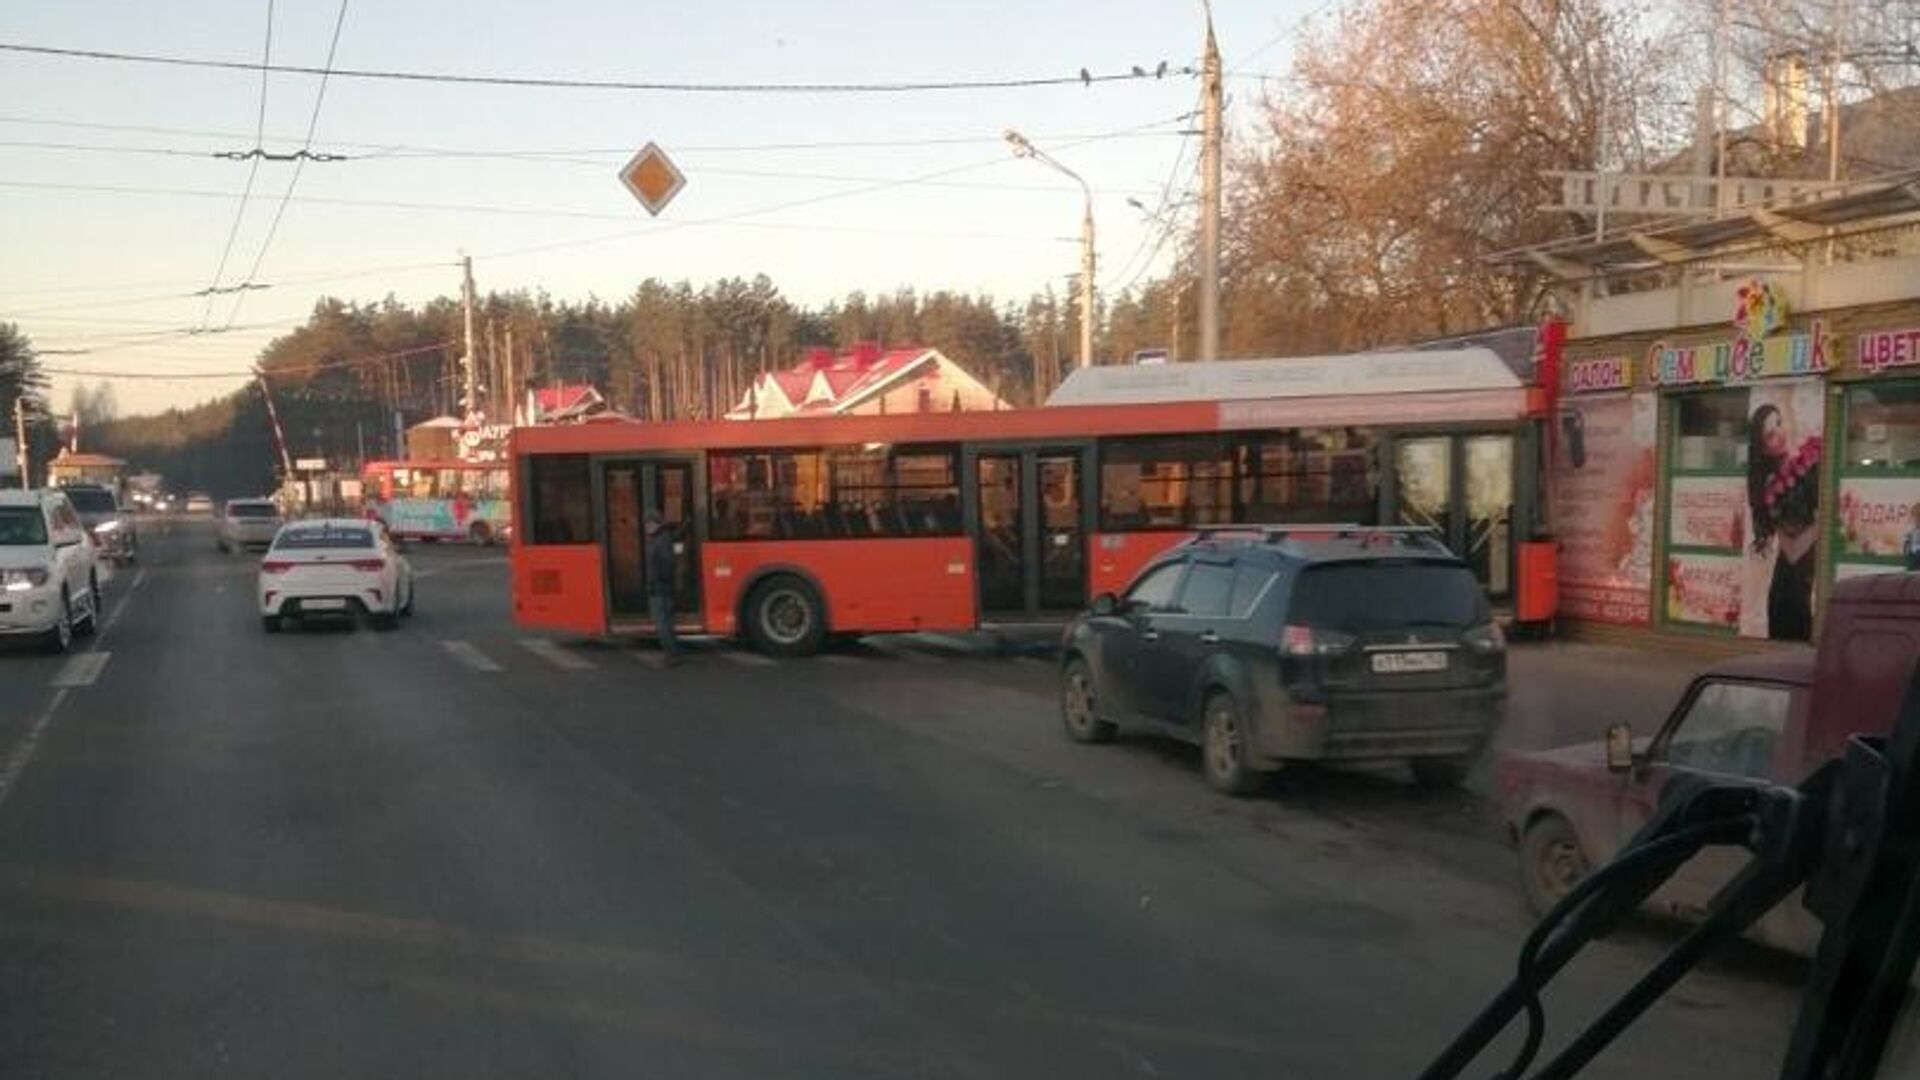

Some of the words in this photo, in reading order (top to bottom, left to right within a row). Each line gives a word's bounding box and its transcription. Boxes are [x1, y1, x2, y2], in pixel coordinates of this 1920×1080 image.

[1649, 320, 1827, 383] Семцвеик
[1860, 331, 1920, 370] ЦВЕТ
[1850, 502, 1911, 525] ОДАР
